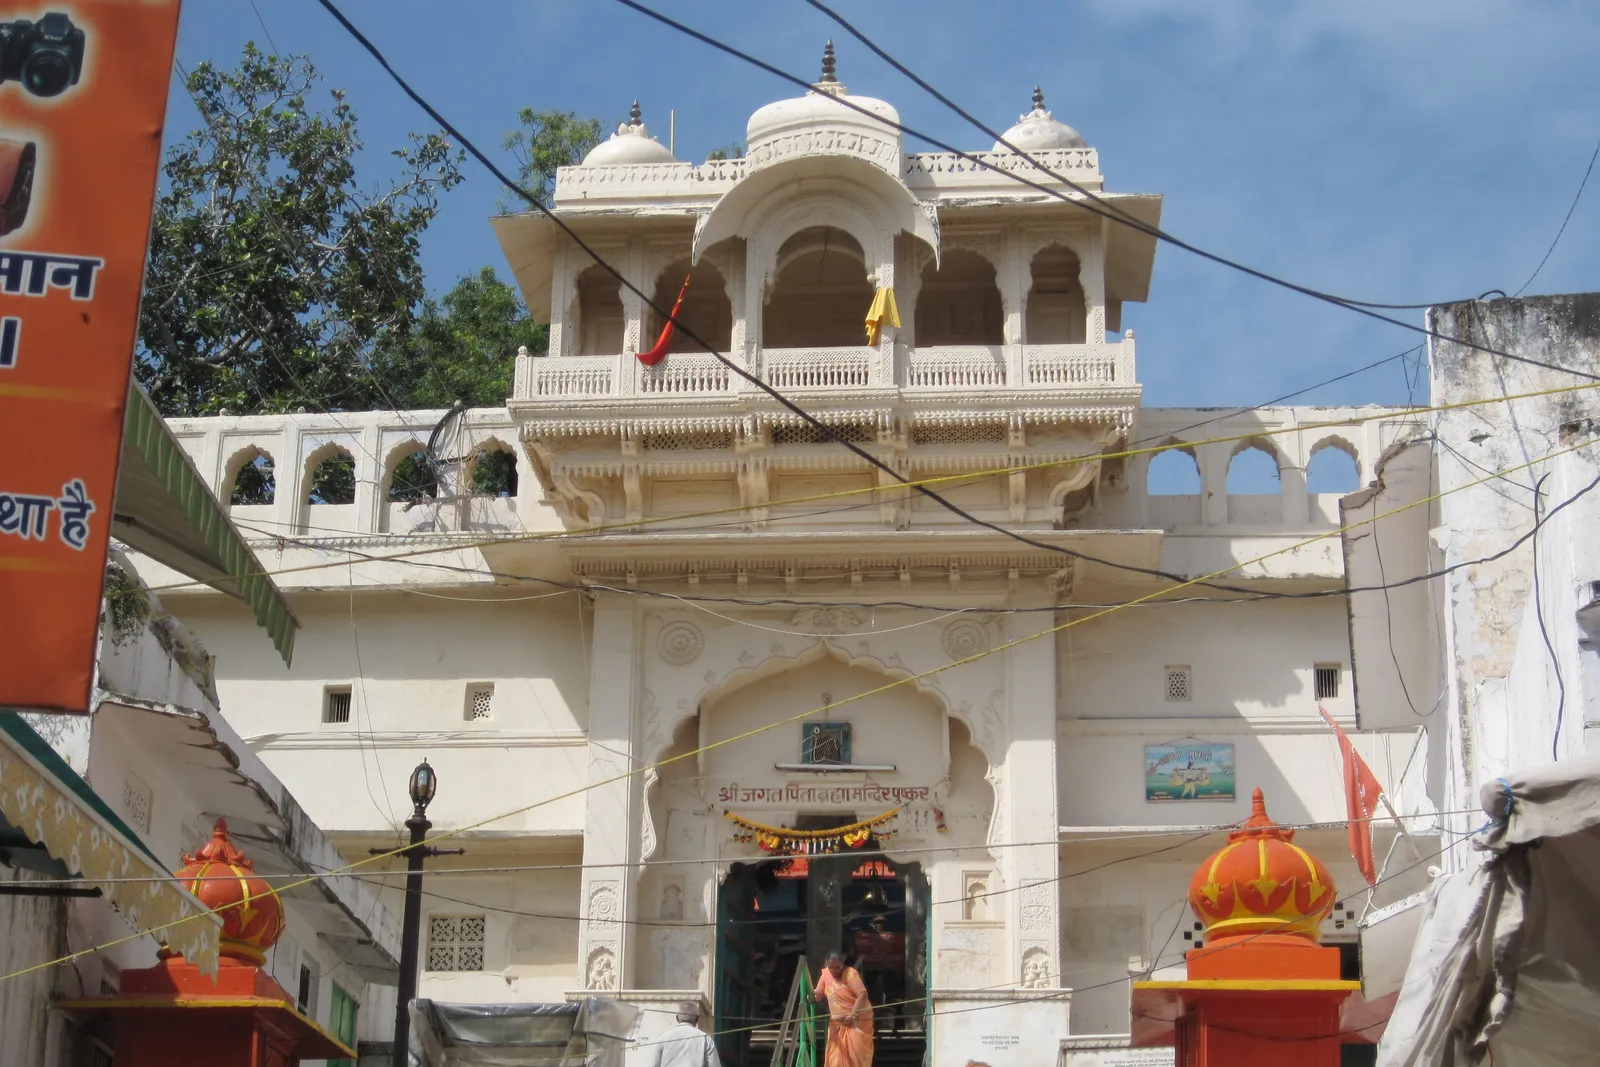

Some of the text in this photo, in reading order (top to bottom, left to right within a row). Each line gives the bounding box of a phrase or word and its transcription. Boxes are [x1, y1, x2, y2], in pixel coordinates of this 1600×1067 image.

[56, 477, 96, 551] है
[718, 782, 739, 802] श्री
[741, 787, 783, 802] जगत
[785, 783, 817, 802] पिता
[891, 786, 929, 804] पुष्कर
